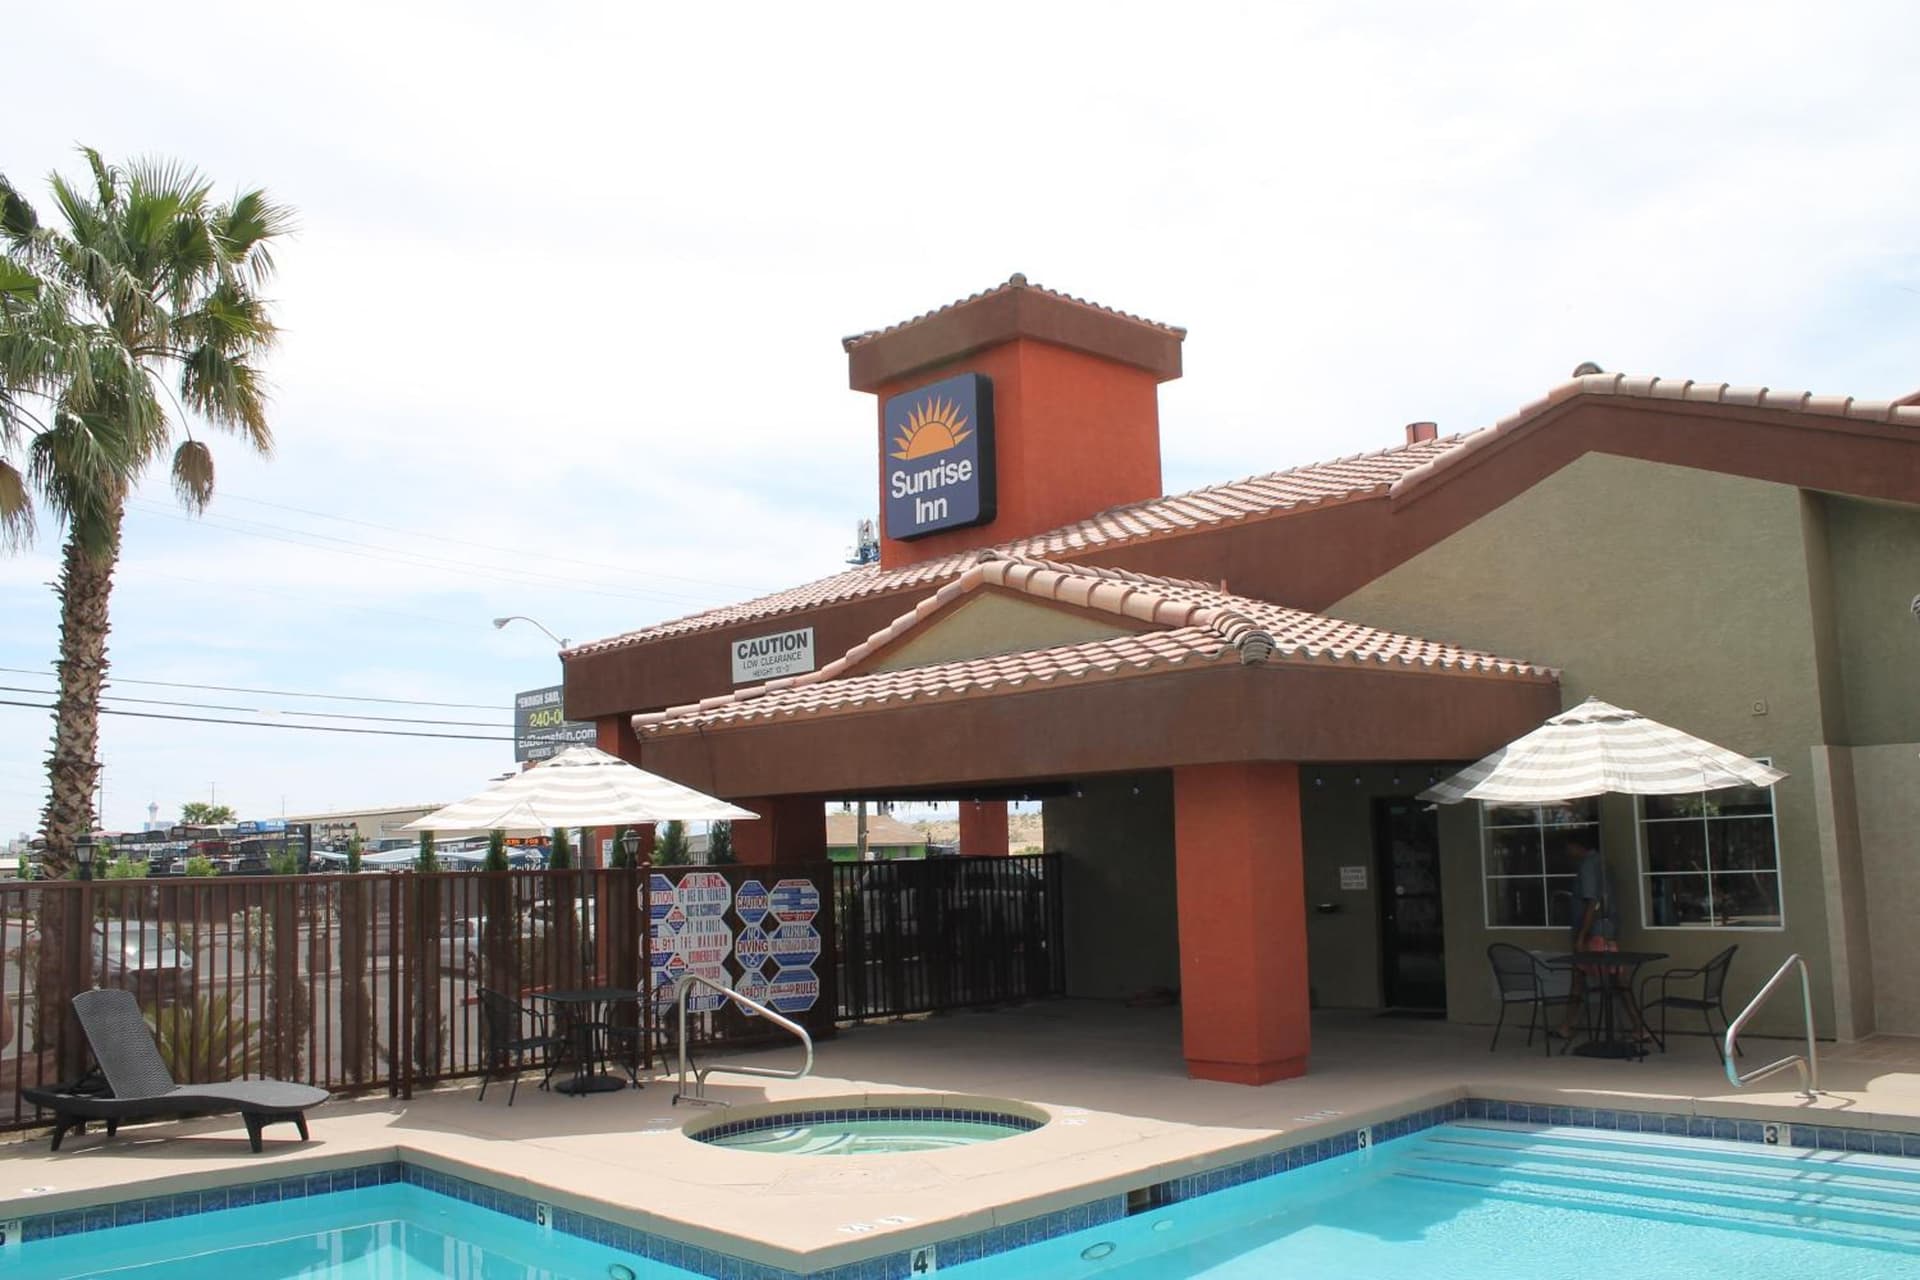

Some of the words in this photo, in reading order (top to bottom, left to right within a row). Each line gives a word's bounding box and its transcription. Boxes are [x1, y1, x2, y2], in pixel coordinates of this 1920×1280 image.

[891, 459, 973, 498] Sunrise
[916, 497, 948, 525] Inn
[737, 631, 808, 660] CAUTION
[743, 660, 758, 670] LOW
[760, 650, 802, 667] CLEARANCE
[650, 891, 673, 905] UTION
[737, 896, 768, 910] CAUTION
[748, 927, 760, 939] NO
[663, 937, 676, 951] 911
[737, 941, 768, 953] DIVING
[796, 983, 817, 994] RULES
[1360, 1131, 1367, 1148] 3
[1766, 1125, 1778, 1145] 3
[538, 1204, 545, 1226] 5
[913, 1250, 928, 1273] 4
